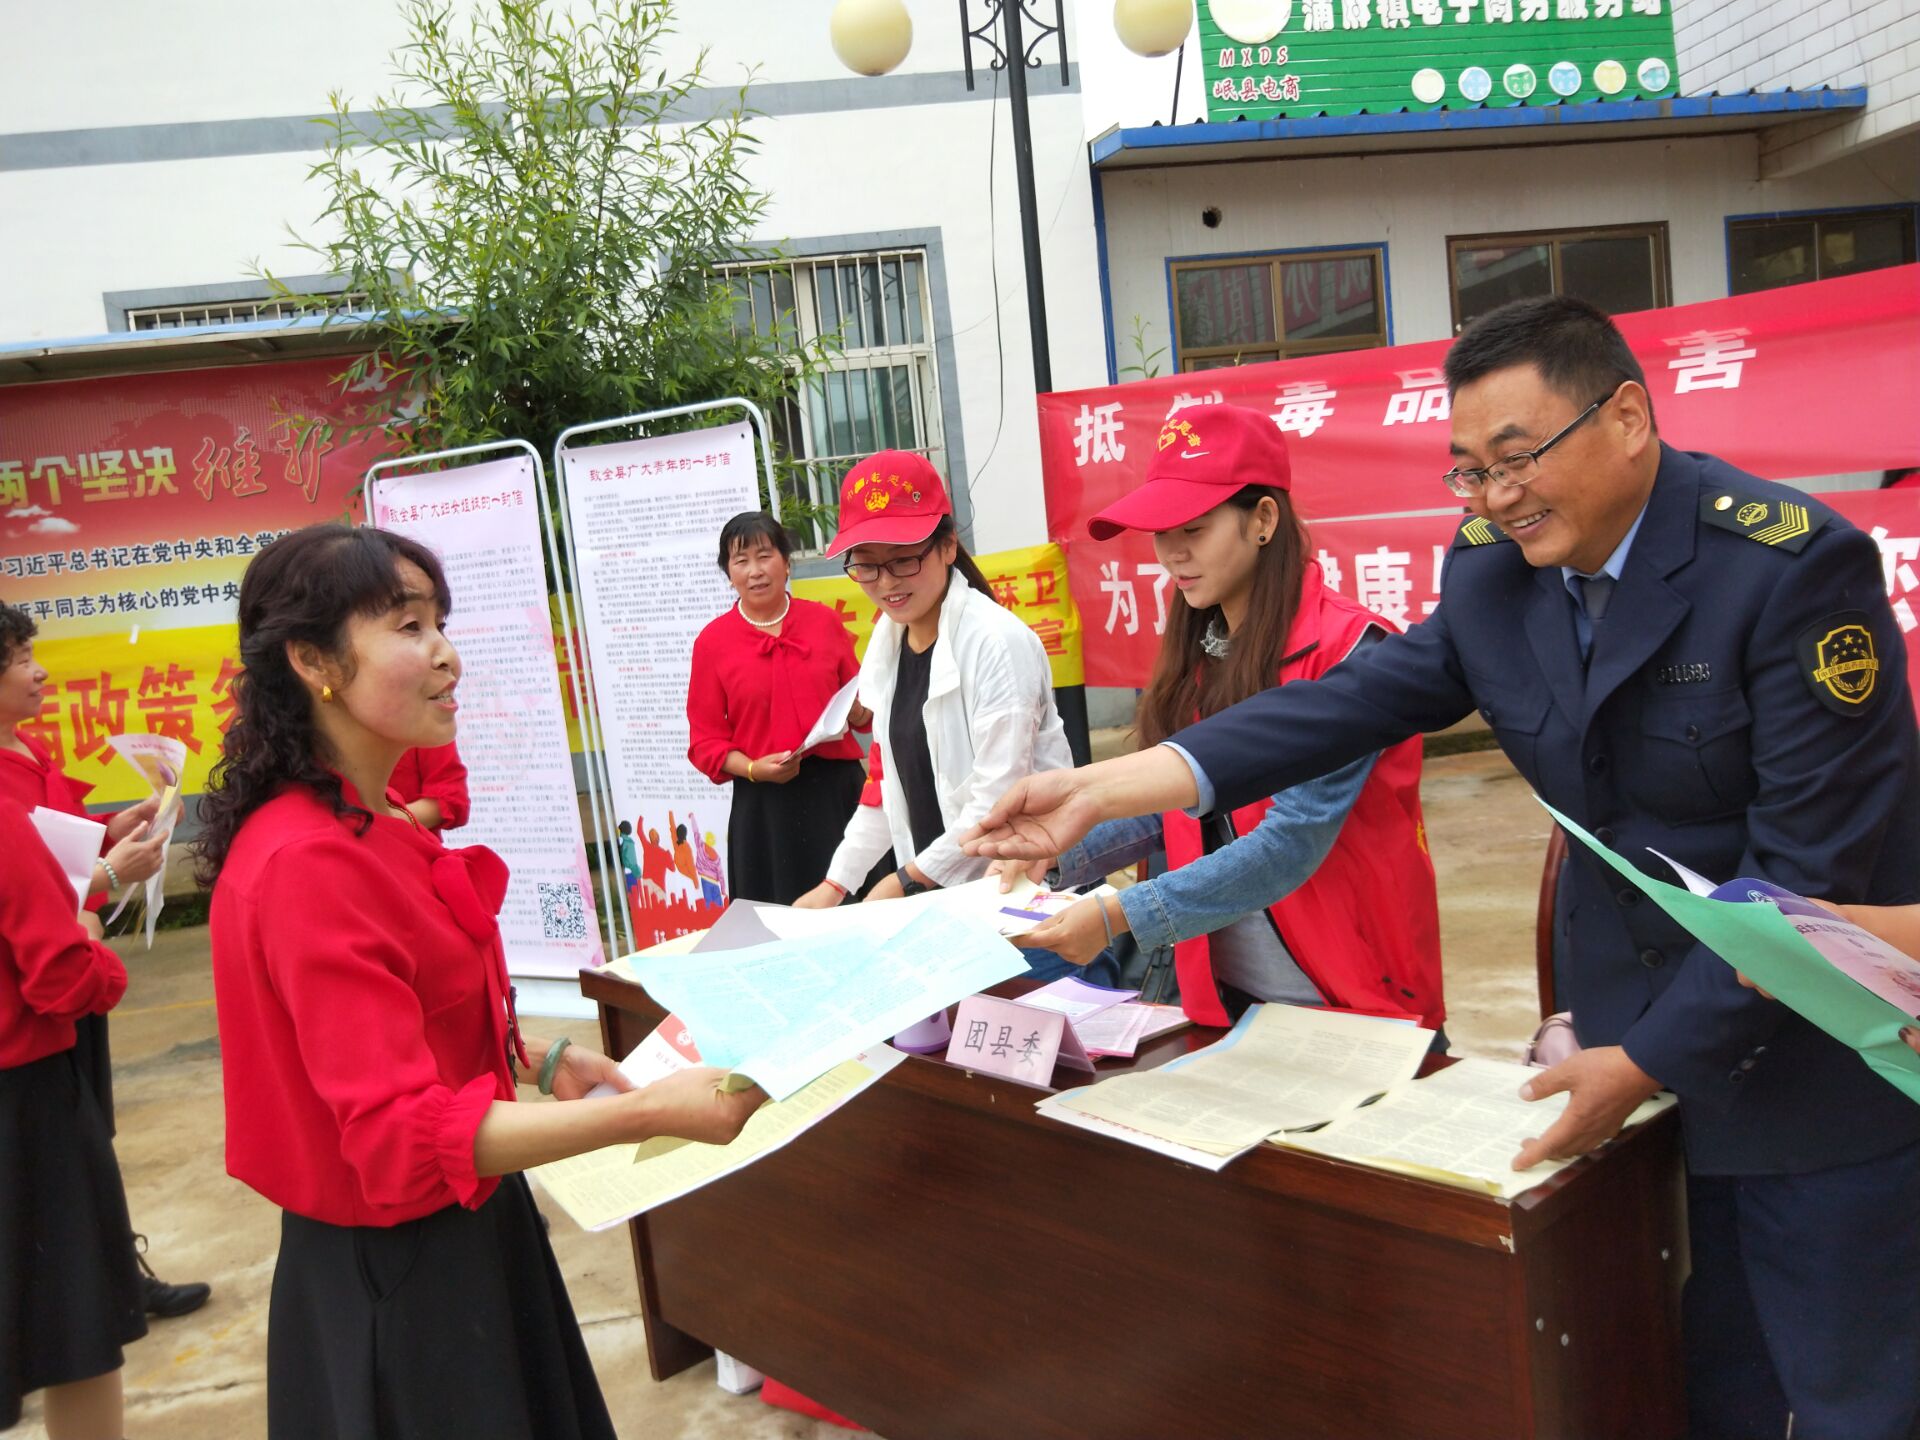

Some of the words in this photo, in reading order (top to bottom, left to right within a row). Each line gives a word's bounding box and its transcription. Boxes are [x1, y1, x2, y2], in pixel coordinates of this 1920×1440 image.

[1219, 47, 1289, 67] MXDS
[1213, 75, 1300, 101] 岷县电商
[1662, 327, 1757, 394] 害
[590, 452, 731, 481] 致全县广大青年的一封信
[0, 531, 291, 577] 习近平总书记在党中央和全党
[964, 1020, 1042, 1066] 团县委
